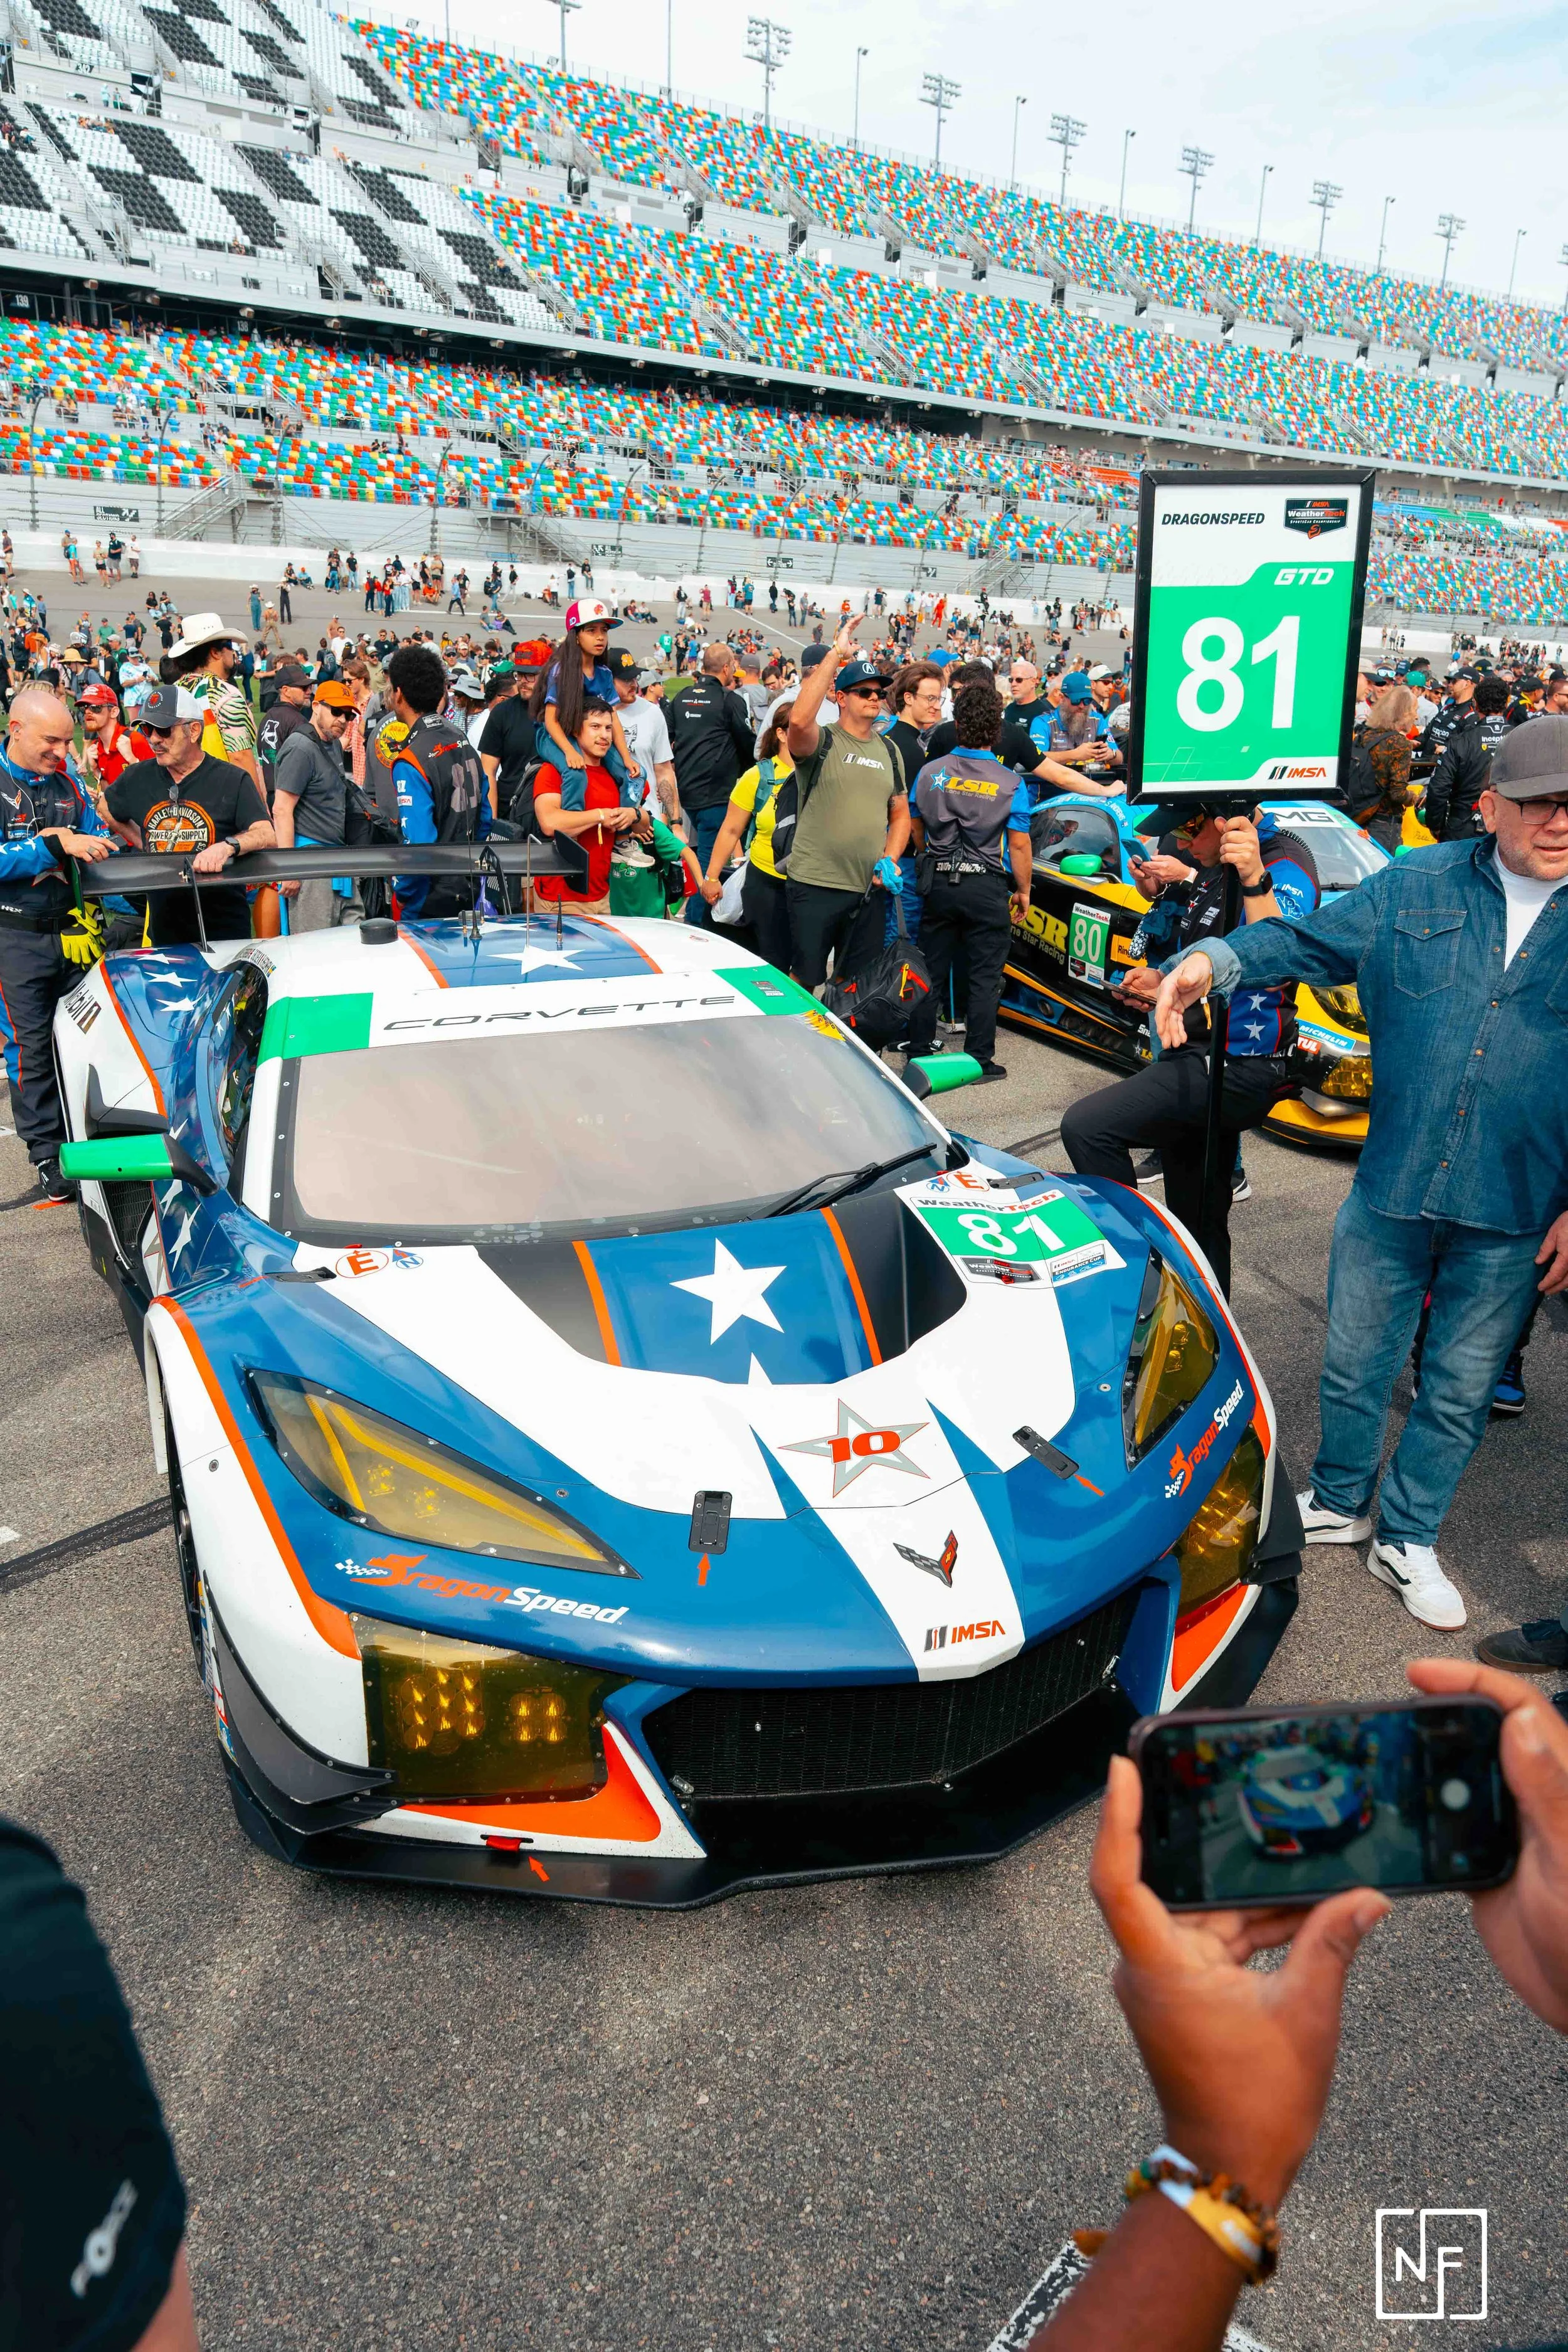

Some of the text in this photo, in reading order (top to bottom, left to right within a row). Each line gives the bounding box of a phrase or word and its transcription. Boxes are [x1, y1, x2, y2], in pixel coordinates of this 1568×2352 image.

[15, 294, 29, 308] 139
[236, 320, 249, 332] 138
[428, 347, 439, 358] 137
[1161, 513, 1265, 525] DRAGONSPEED
[1274, 568, 1335, 585] GTD
[1176, 615, 1300, 732] 81
[1481, 736, 1505, 745] Incept
[857, 756, 885, 770] IMSA
[1286, 767, 1327, 778] IMSA
[945, 776, 999, 796] LSR
[975, 792, 996, 802] Racing
[1274, 811, 1334, 823] MG
[181, 830, 206, 840] SUPPLY
[1, 905, 23, 914] HRX
[1075, 906, 1109, 923] WeatherTech
[1010, 926, 1064, 965] ne Star Racing
[1074, 919, 1101, 962] 80
[383, 996, 735, 1031] CORVETTE
[1298, 1036, 1317, 1052] TUL
[1300, 1025, 1348, 1047] MICHELIN
[918, 1192, 1056, 1212] WeatherTech
[957, 1214, 1066, 1255] 81
[1056, 1261, 1088, 1275] ENDURANCE
[1169, 1379, 1243, 1497] DragonSpeed
[826, 1429, 902, 1465] 10
[349, 1554, 630, 1624] DragonSpeed
[951, 1620, 1006, 1644] IMSA
